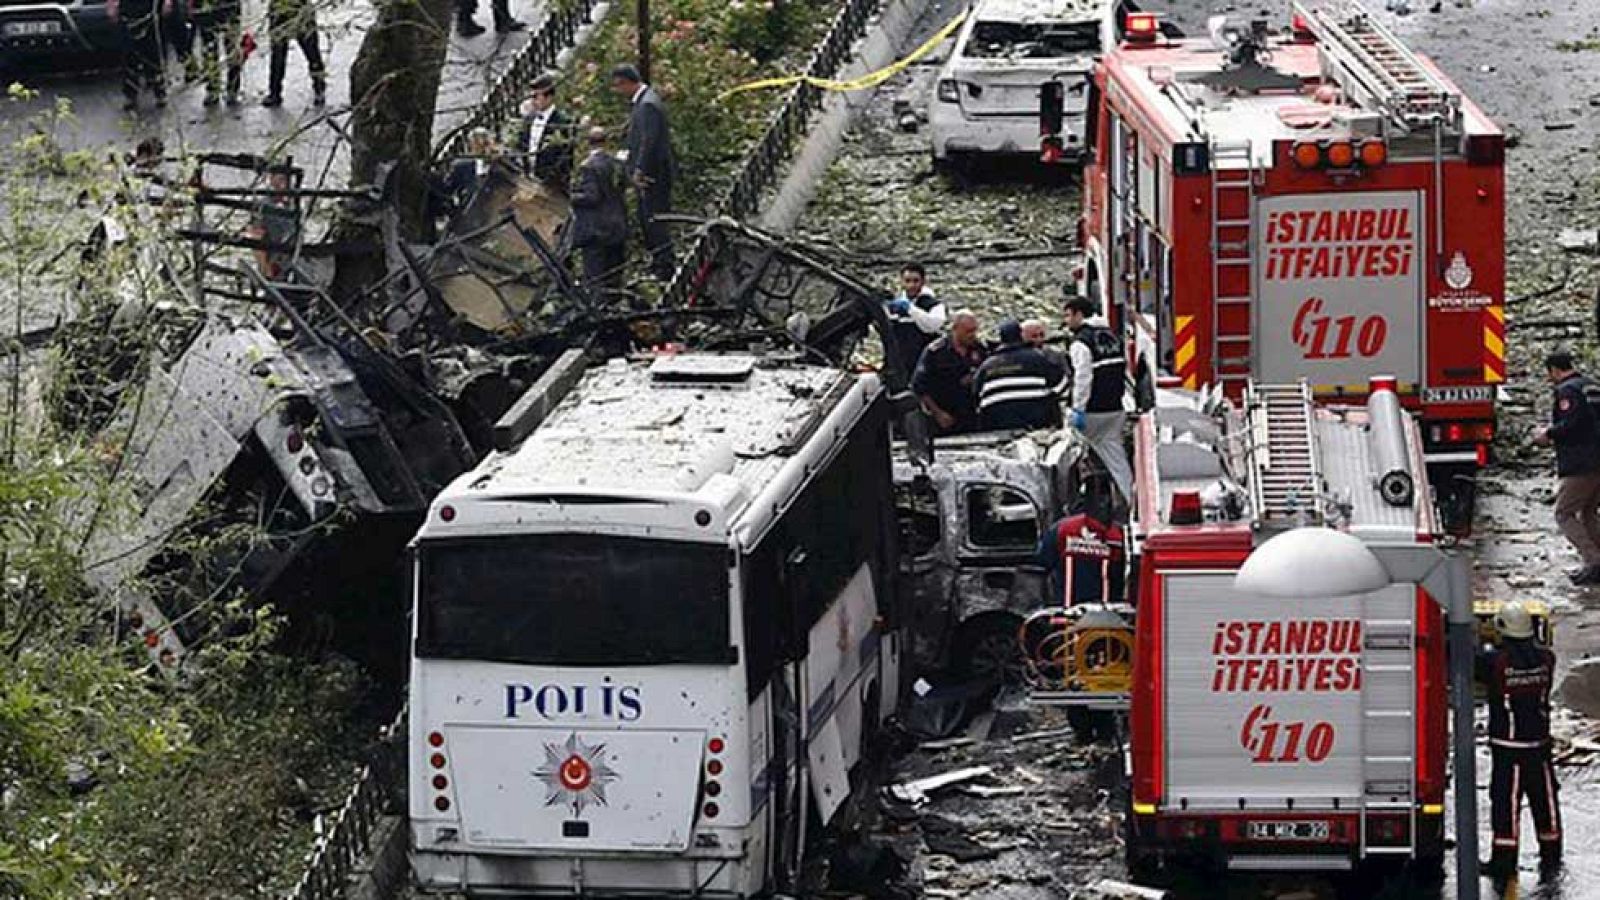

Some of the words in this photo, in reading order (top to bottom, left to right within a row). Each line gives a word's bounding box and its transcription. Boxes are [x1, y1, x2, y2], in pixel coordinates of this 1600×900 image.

[1265, 208, 1413, 243] İSTANBUL
[1303, 314, 1387, 360] 110
[1252, 721, 1335, 763] 110
